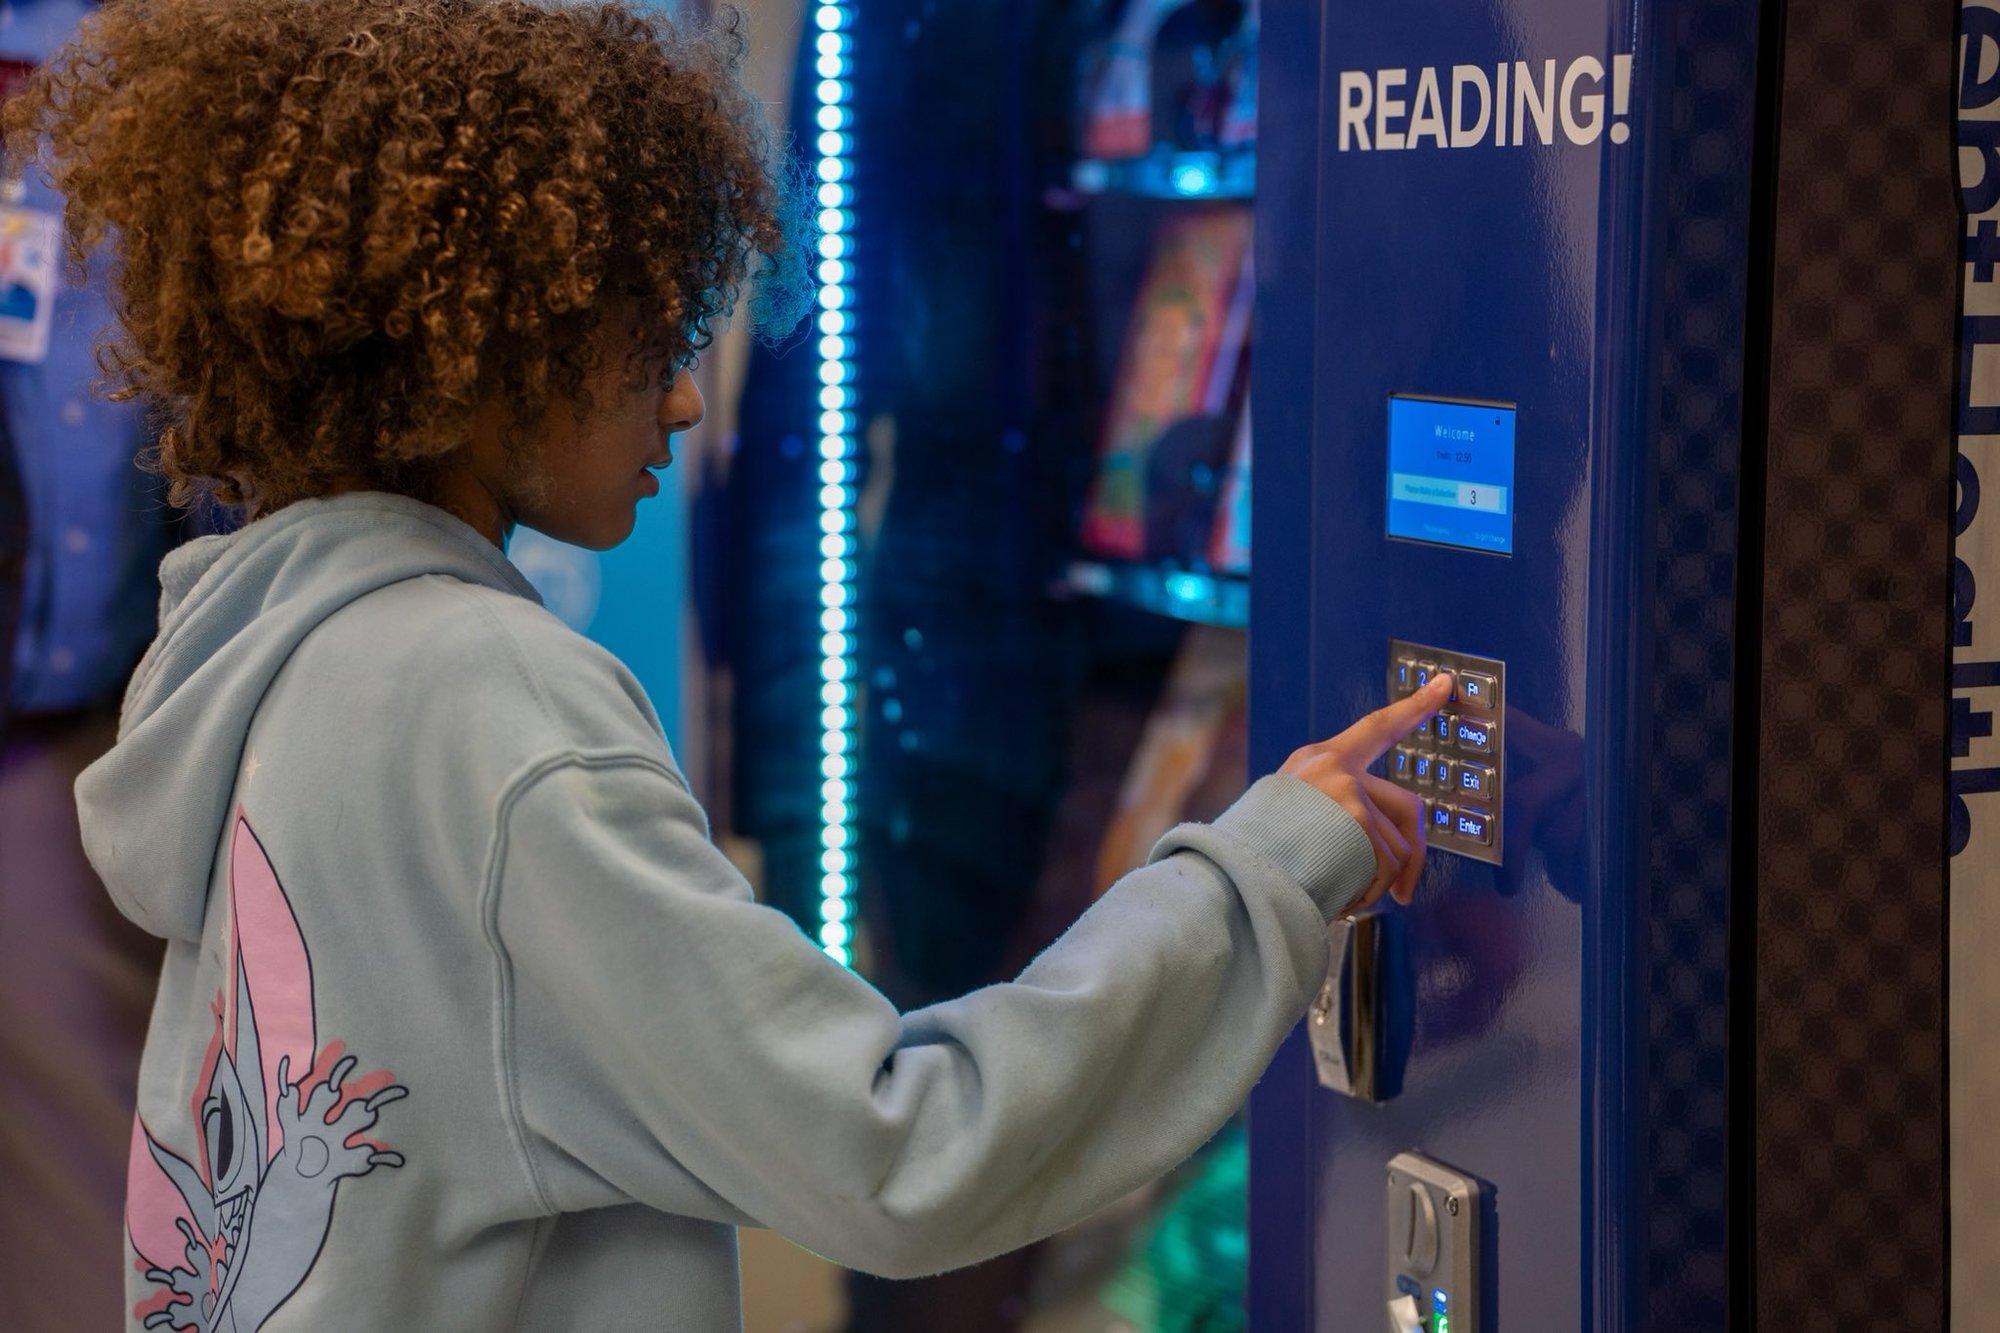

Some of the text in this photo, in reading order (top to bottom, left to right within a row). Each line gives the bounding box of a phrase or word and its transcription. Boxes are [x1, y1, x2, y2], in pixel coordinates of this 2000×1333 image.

[1339, 54, 1632, 151] READING!
[1434, 425, 1475, 441] Welcome
[1470, 490, 1477, 505] 3
[1400, 667, 1406, 682] 1
[1419, 672, 1427, 686] 2
[1467, 682, 1479, 696] Fn
[1440, 721, 1447, 736] 6
[1397, 755, 1405, 770] 7
[1418, 761, 1426, 775] 8
[1439, 767, 1447, 781] 9
[1463, 773, 1480, 790] Exit
[1459, 817, 1482, 836] Enter
